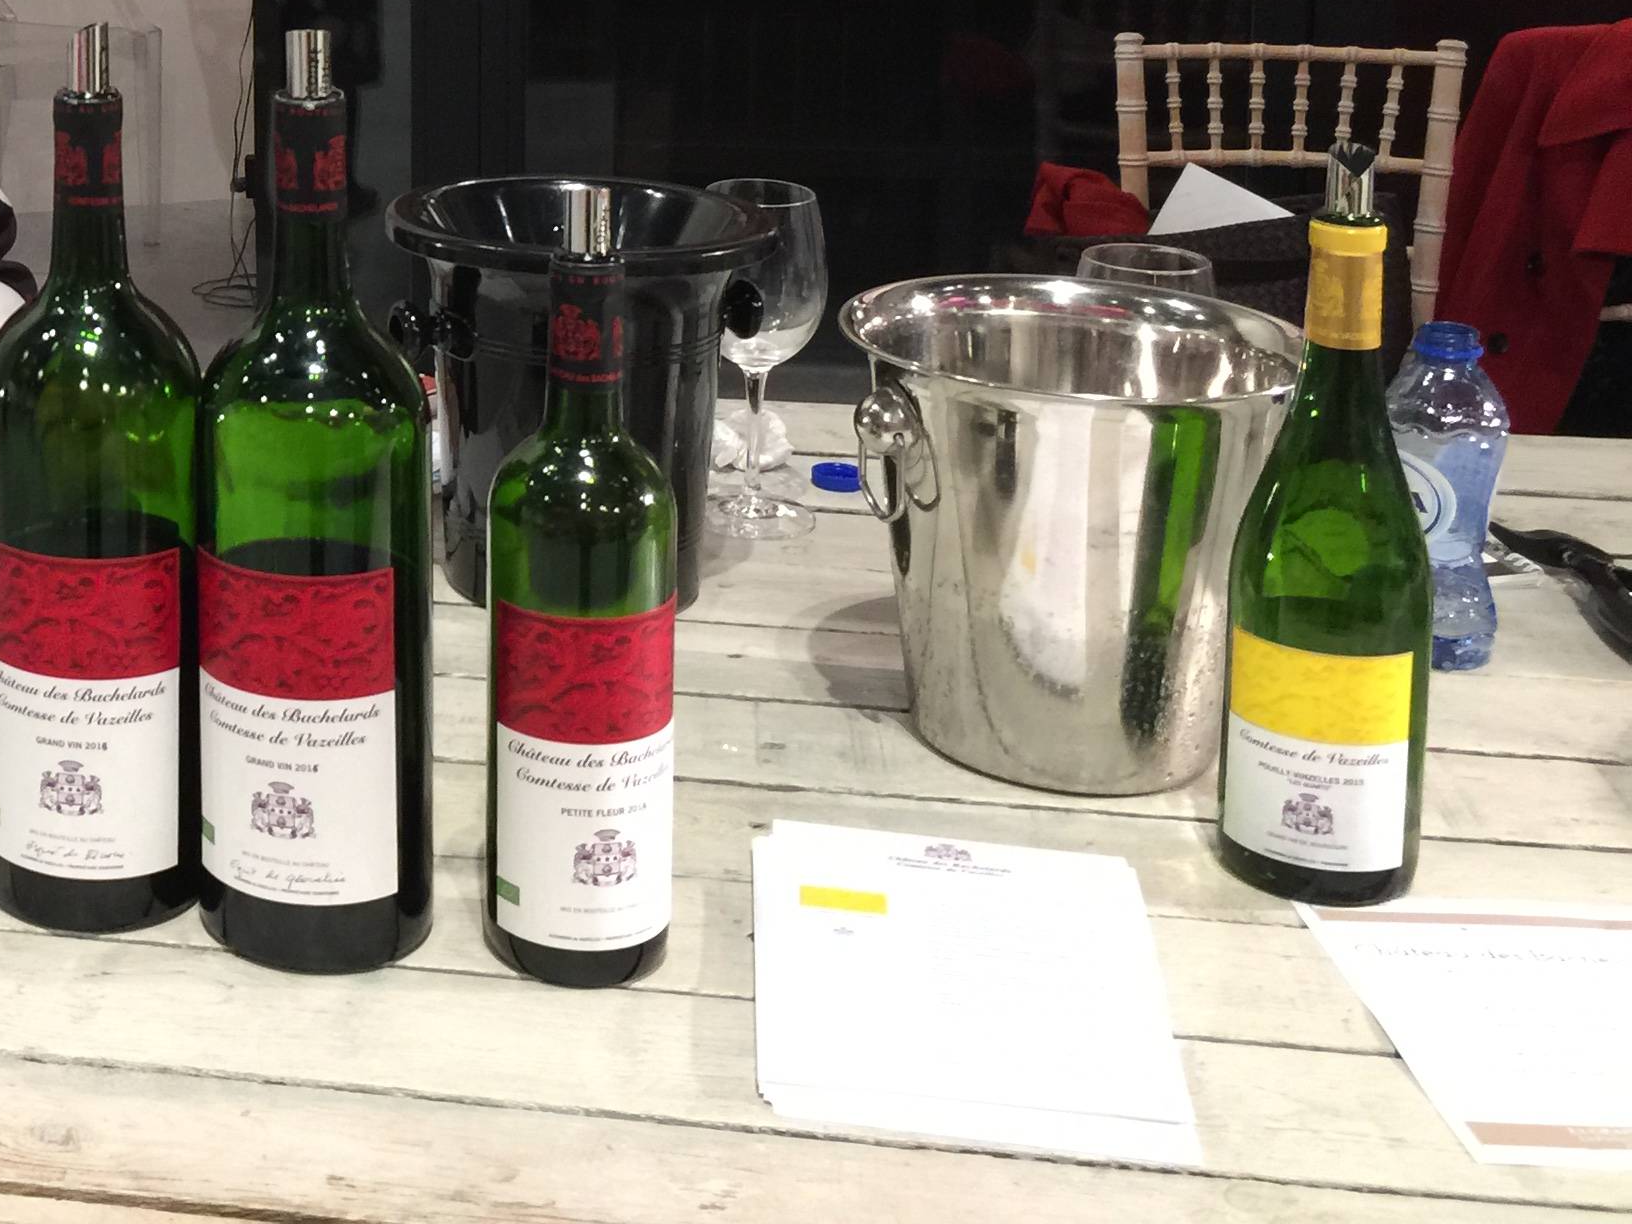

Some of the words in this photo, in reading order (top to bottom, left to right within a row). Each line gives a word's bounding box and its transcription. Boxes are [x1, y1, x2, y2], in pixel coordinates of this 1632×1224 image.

[43, 684, 68, 701] des
[72, 680, 167, 703] Bachelards
[59, 710, 81, 725] de
[84, 707, 154, 726] Vazeilles
[251, 703, 276, 721] des
[281, 702, 381, 724] Bachelards
[209, 709, 265, 742] Comtesse
[268, 730, 288, 746] de
[294, 730, 367, 748] Vazeilles
[35, 735, 66, 748] GRAND
[67, 740, 83, 750] VIN
[507, 738, 571, 767] Château
[576, 753, 605, 769] des
[1239, 727, 1298, 759] Comtesse
[1301, 749, 1321, 763] de
[245, 755, 275, 769] GRAND
[277, 761, 293, 771] VIN
[516, 766, 593, 793] Comtesse
[595, 776, 616, 792] de
[560, 807, 593, 818] PETITE
[596, 807, 625, 817] FLEUR
